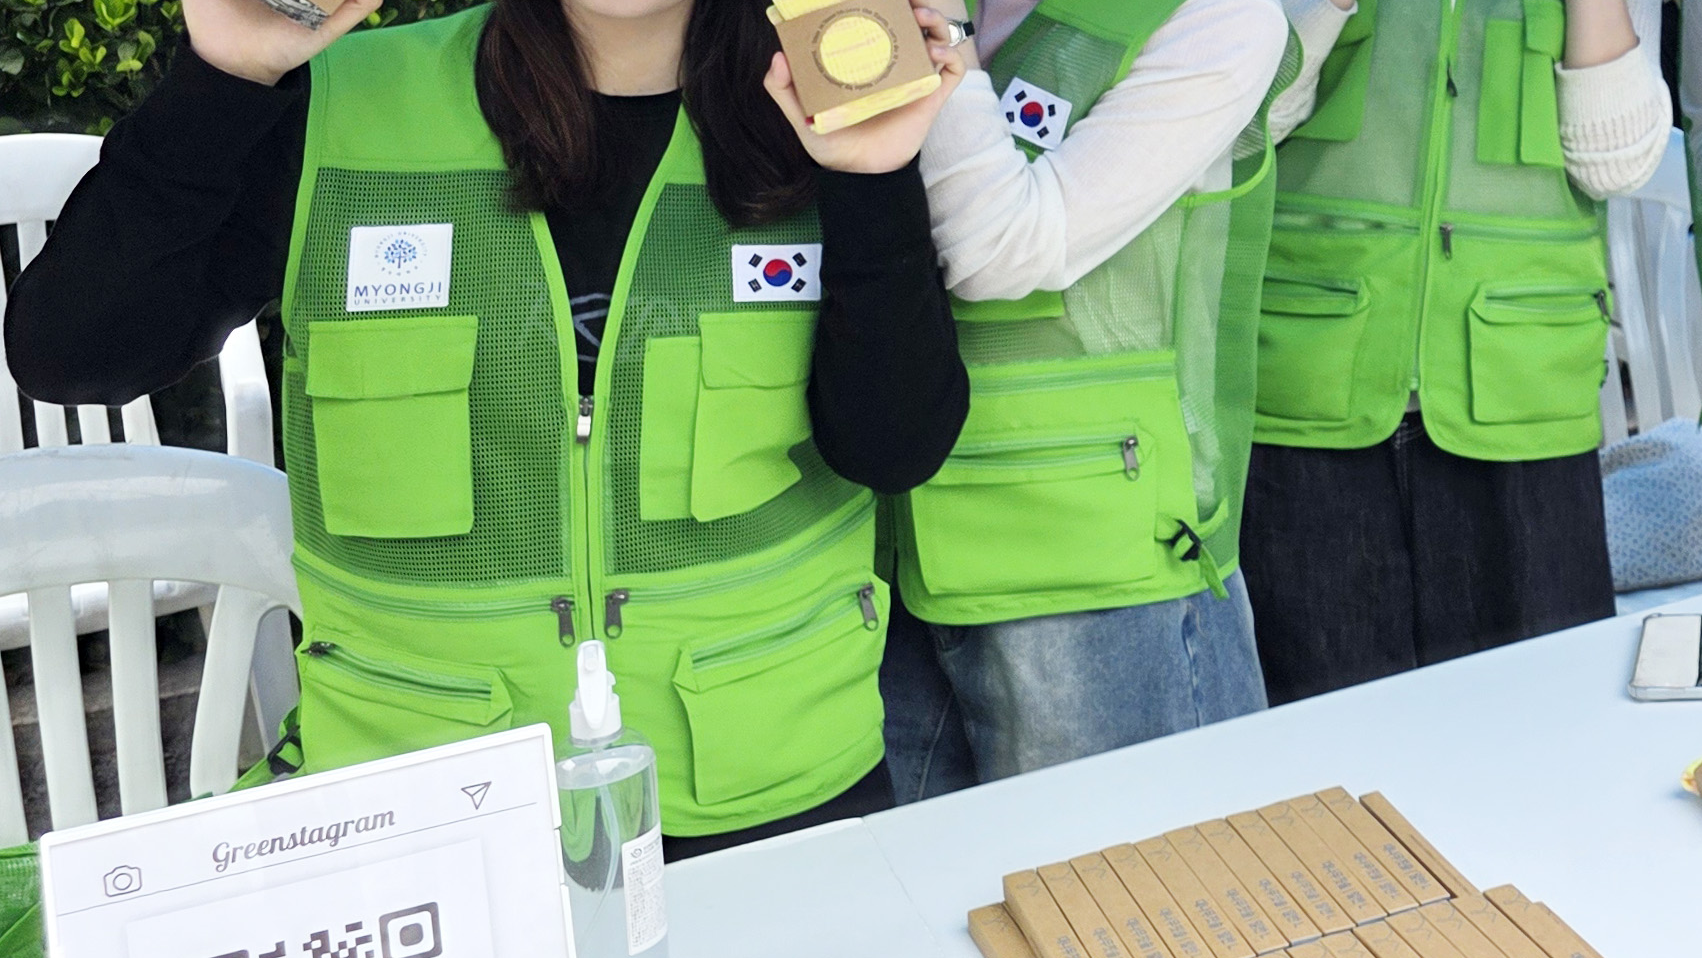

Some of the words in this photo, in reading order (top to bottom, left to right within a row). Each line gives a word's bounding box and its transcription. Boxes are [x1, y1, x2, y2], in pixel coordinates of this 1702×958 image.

[354, 281, 442, 298] MYONGJI
[354, 294, 441, 306] UNIVERSITY
[212, 810, 397, 873] Greenstagram
